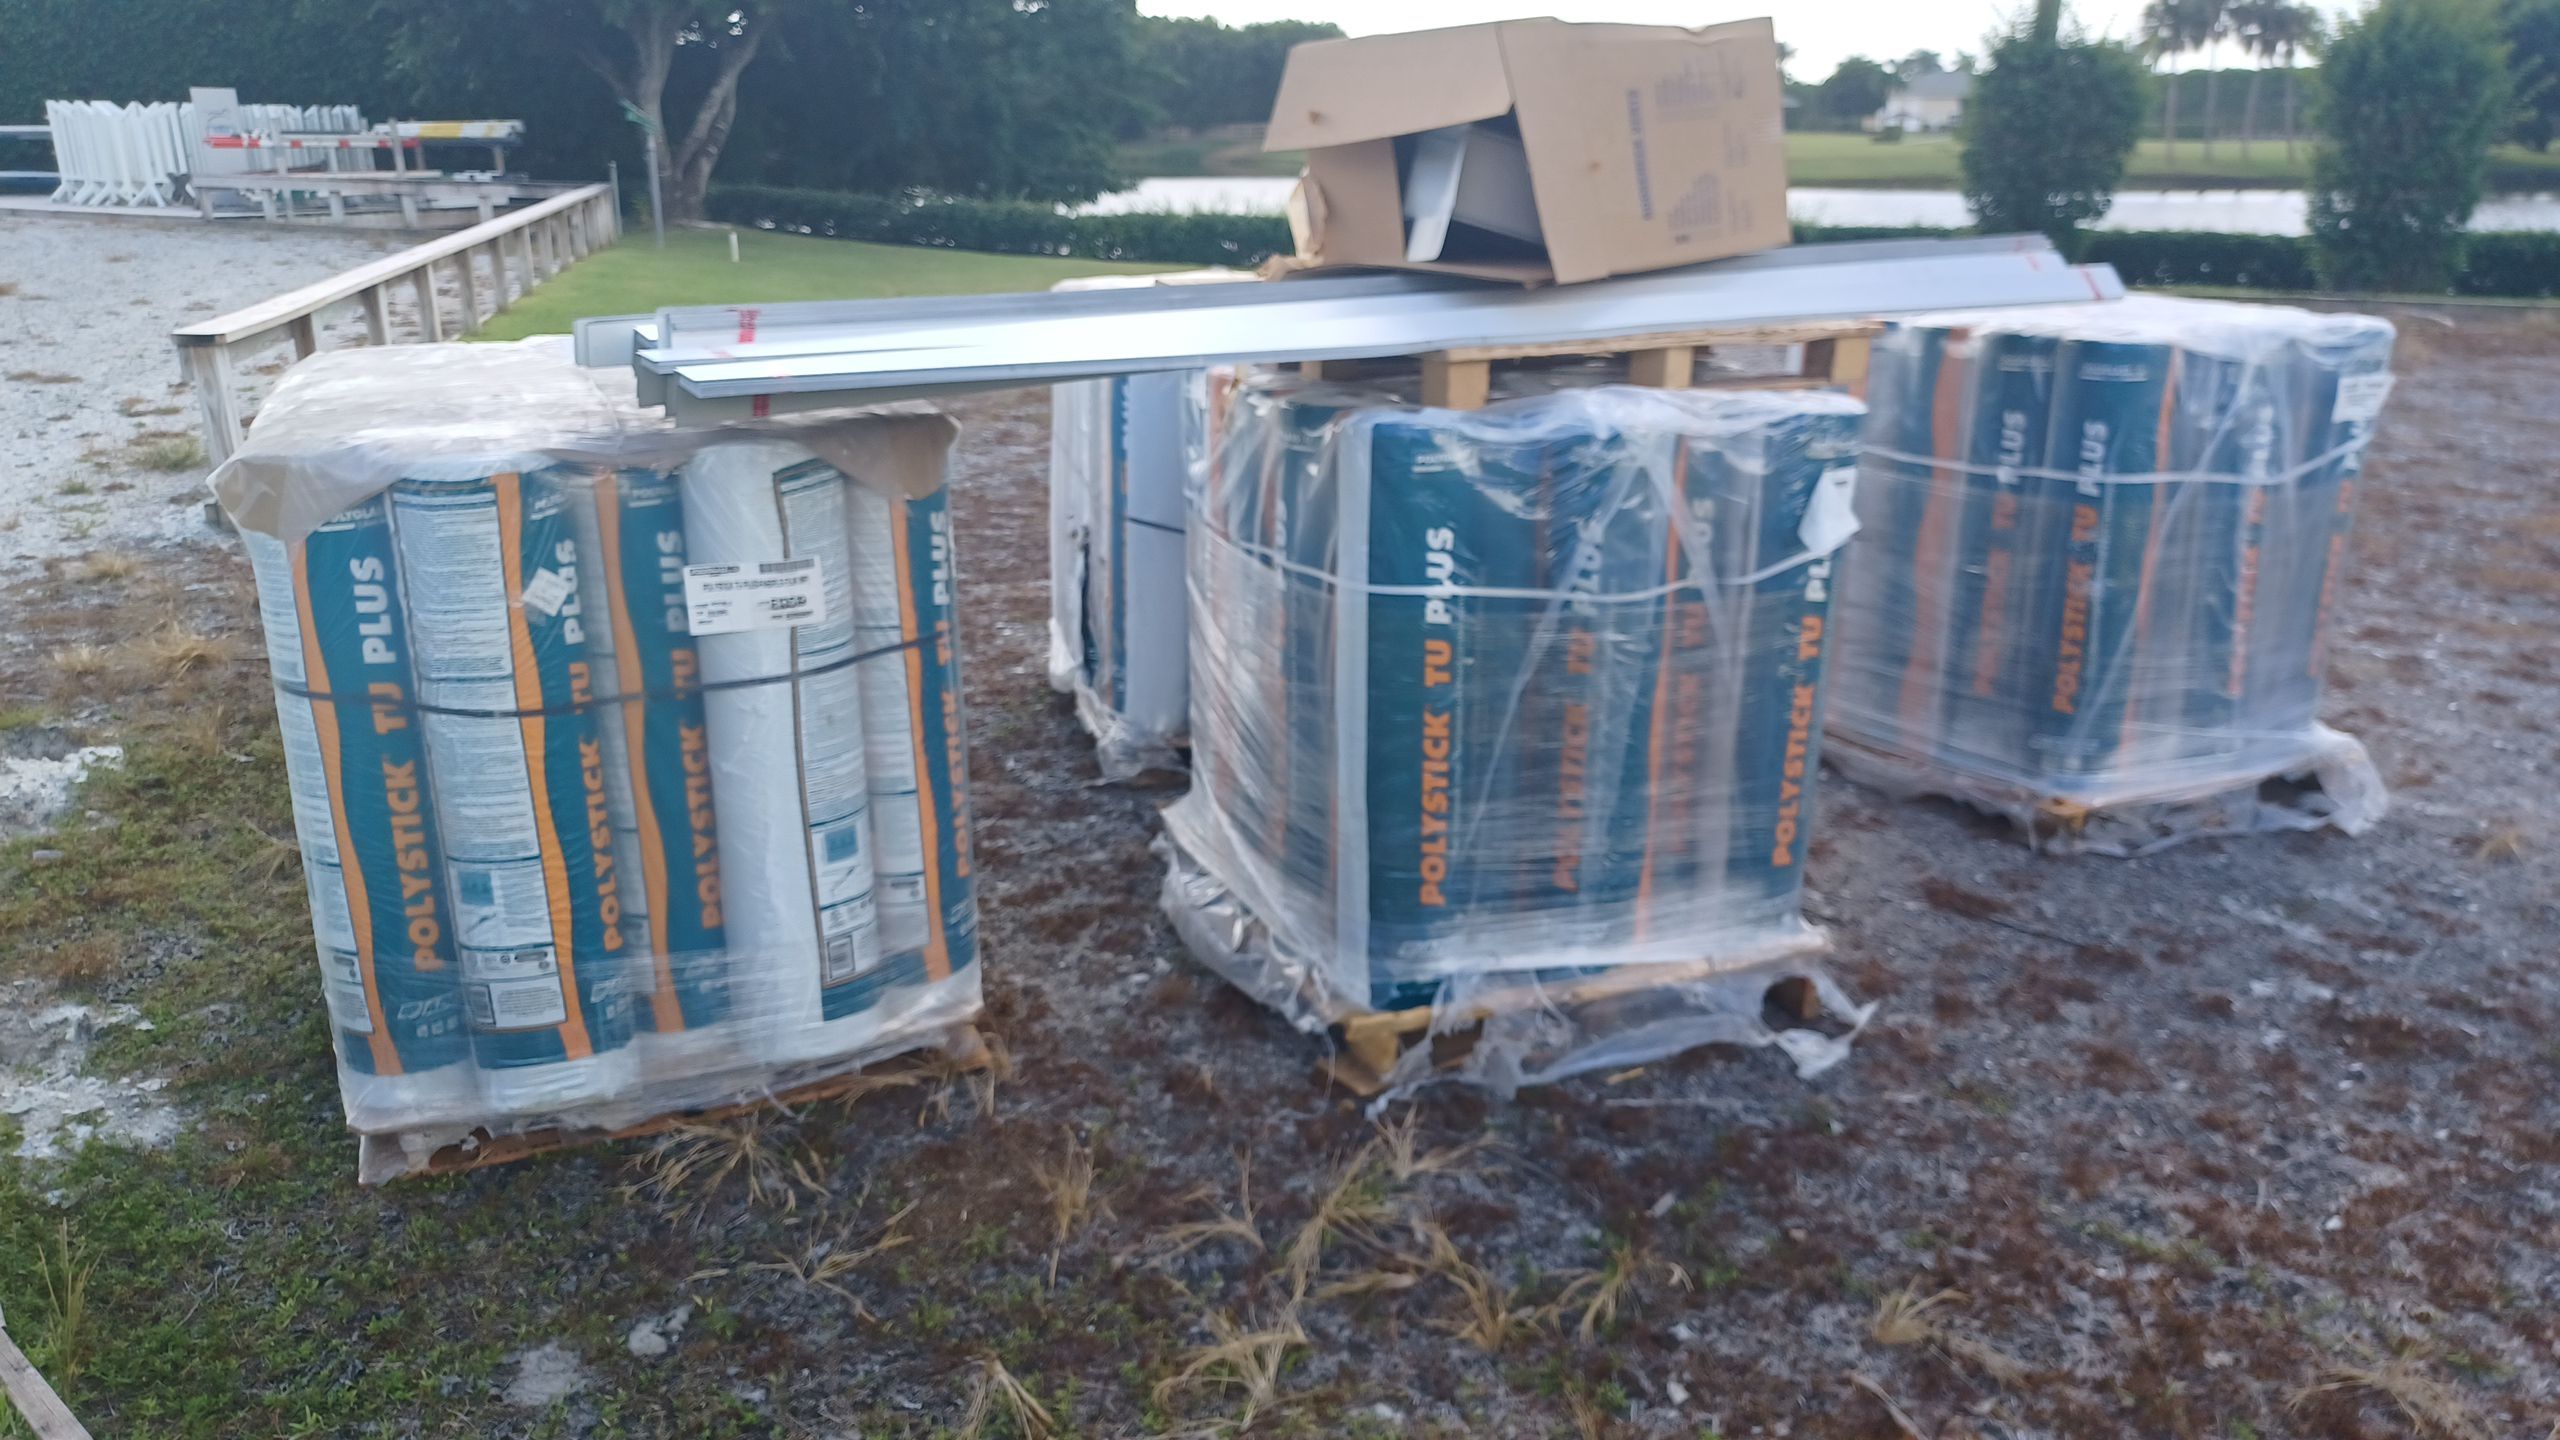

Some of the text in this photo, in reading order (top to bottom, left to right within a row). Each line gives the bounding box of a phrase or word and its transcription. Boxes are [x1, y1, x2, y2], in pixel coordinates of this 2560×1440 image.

[2076, 419, 2109, 497] PLUS
[931, 511, 951, 606] PLUS
[2072, 504, 2099, 543] TU
[350, 556, 396, 664] PLUS
[657, 531, 689, 633] PLUS
[1425, 527, 1456, 625] PLUS
[1424, 640, 1453, 688] TU
[2052, 559, 2093, 715] POLYSTICK
[368, 682, 408, 735] TU
[568, 662, 592, 715] TU
[1772, 555, 1832, 868] POLYSTICK TU PL
[579, 737, 623, 952] POLYSTICK
[680, 720, 723, 930] POLYSTICK
[1420, 710, 1452, 907] POLYSTICK
[382, 760, 444, 973] POLYSTICK
